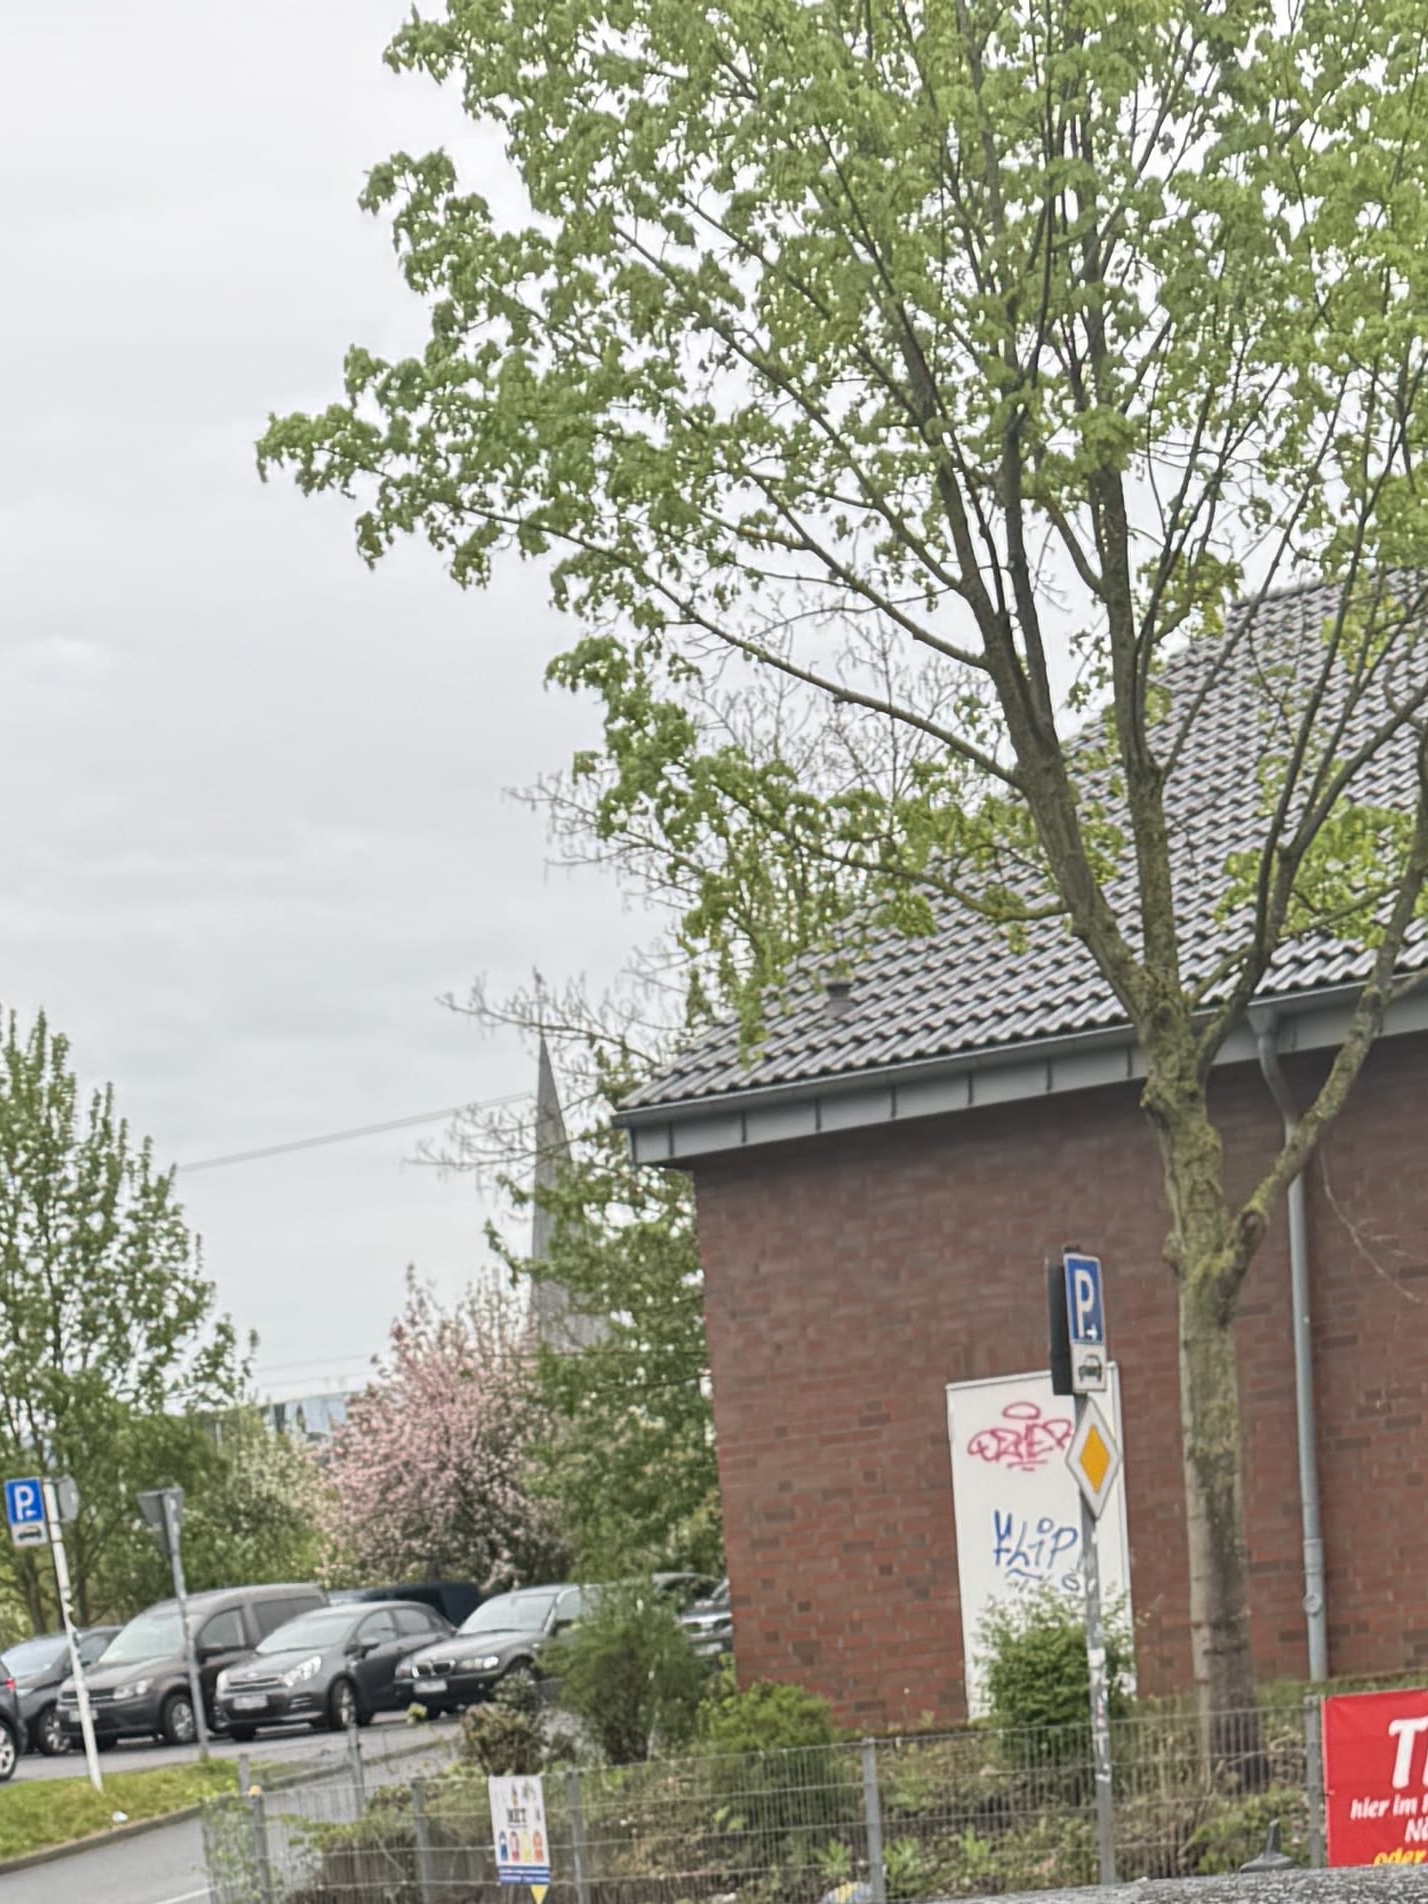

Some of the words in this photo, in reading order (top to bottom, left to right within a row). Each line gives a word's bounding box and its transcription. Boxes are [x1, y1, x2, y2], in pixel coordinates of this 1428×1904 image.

[1074, 1269, 1094, 1338] P
[14, 1485, 35, 1520] P
[1393, 1794, 1418, 1816] im
